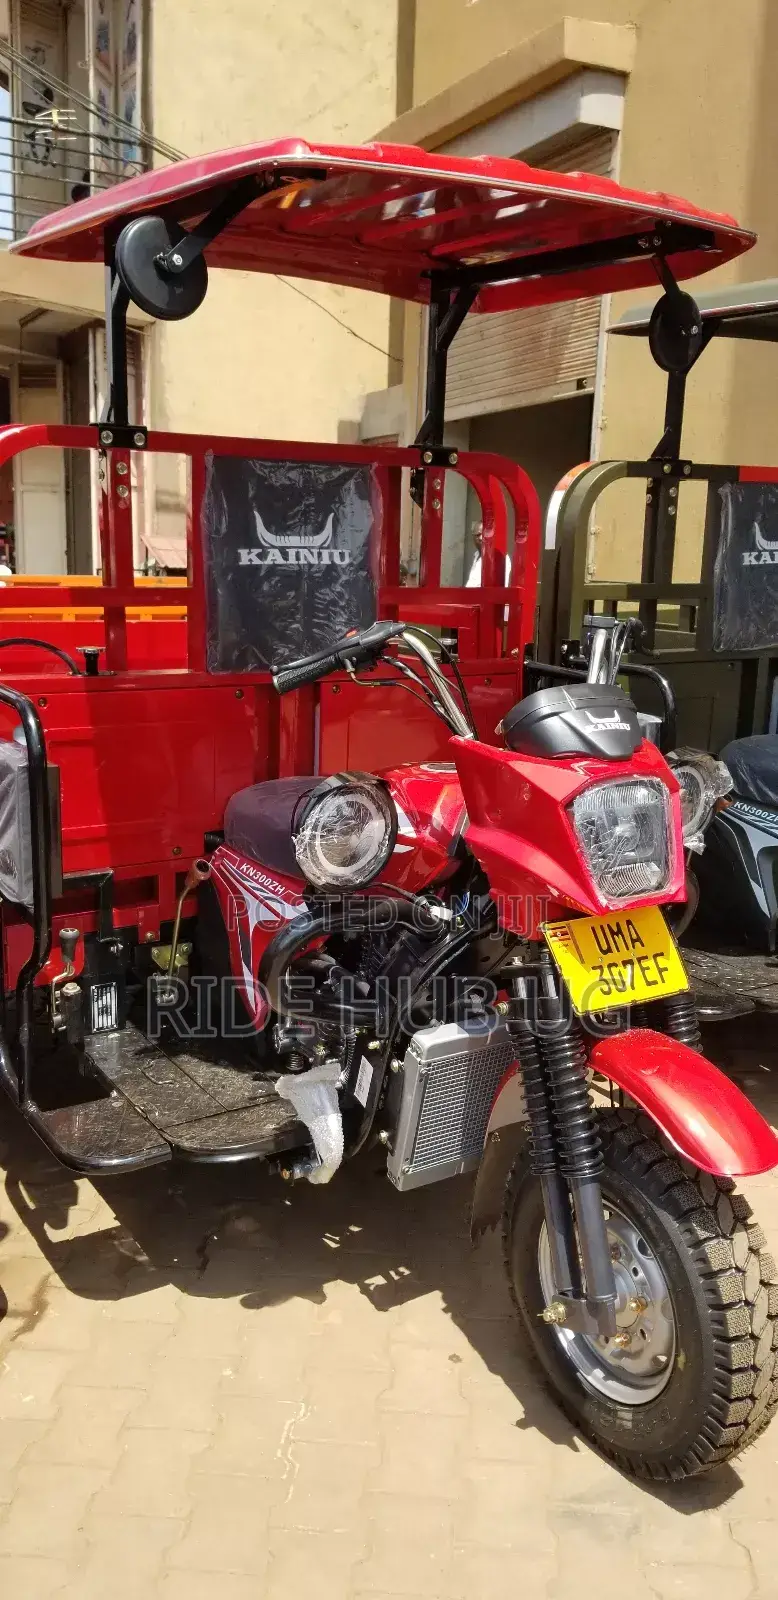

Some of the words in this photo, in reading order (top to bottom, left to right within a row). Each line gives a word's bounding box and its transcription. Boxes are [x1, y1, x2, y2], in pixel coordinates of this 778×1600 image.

[237, 548, 351, 565] KAINIU
[239, 862, 286, 895] KN300ZH
[591, 919, 645, 956] UMA
[591, 951, 670, 996] 307EF
